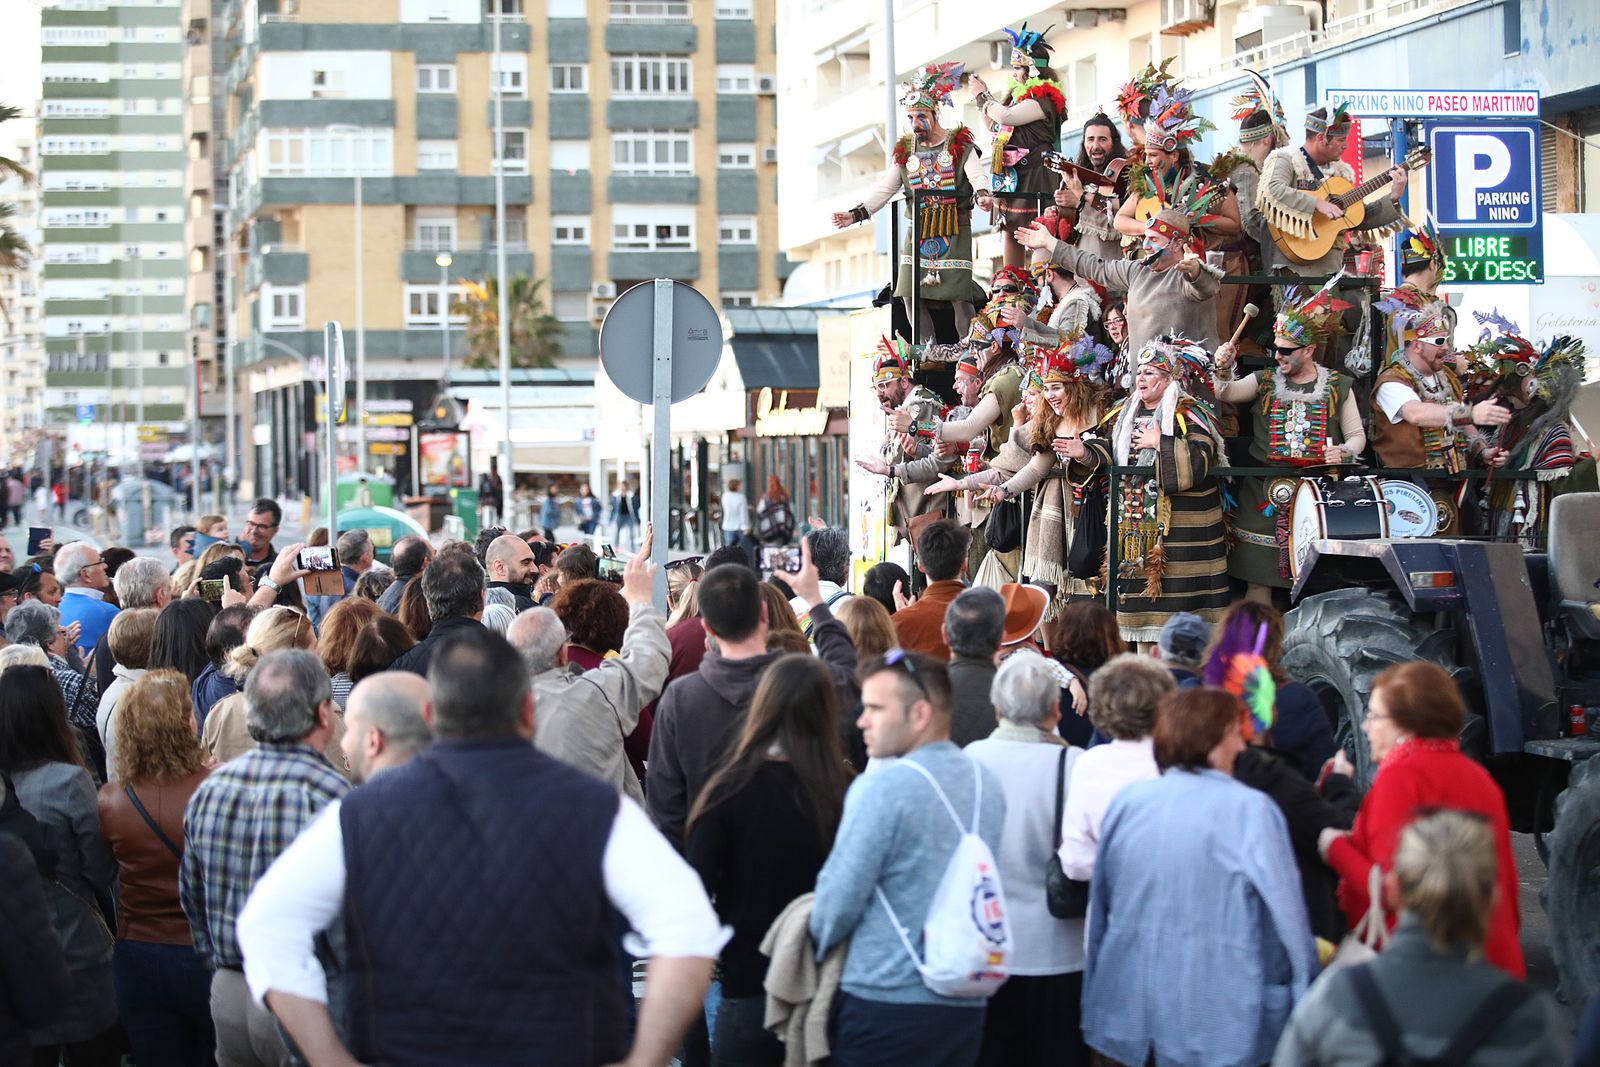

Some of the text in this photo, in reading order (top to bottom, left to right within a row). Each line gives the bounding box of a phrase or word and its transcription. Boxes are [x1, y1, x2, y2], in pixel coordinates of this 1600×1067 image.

[1393, 95, 1424, 111] NINO
[1428, 95, 1468, 112] PASEO
[1472, 95, 1535, 112] MARITIMO
[1454, 134, 1512, 220] P
[1476, 191, 1530, 206] PARKING
[1489, 207, 1519, 220] NINO
[1455, 237, 1510, 257] LIBRE
[1462, 260, 1479, 280] Y
[1395, 489, 1428, 514] PIRULINES
